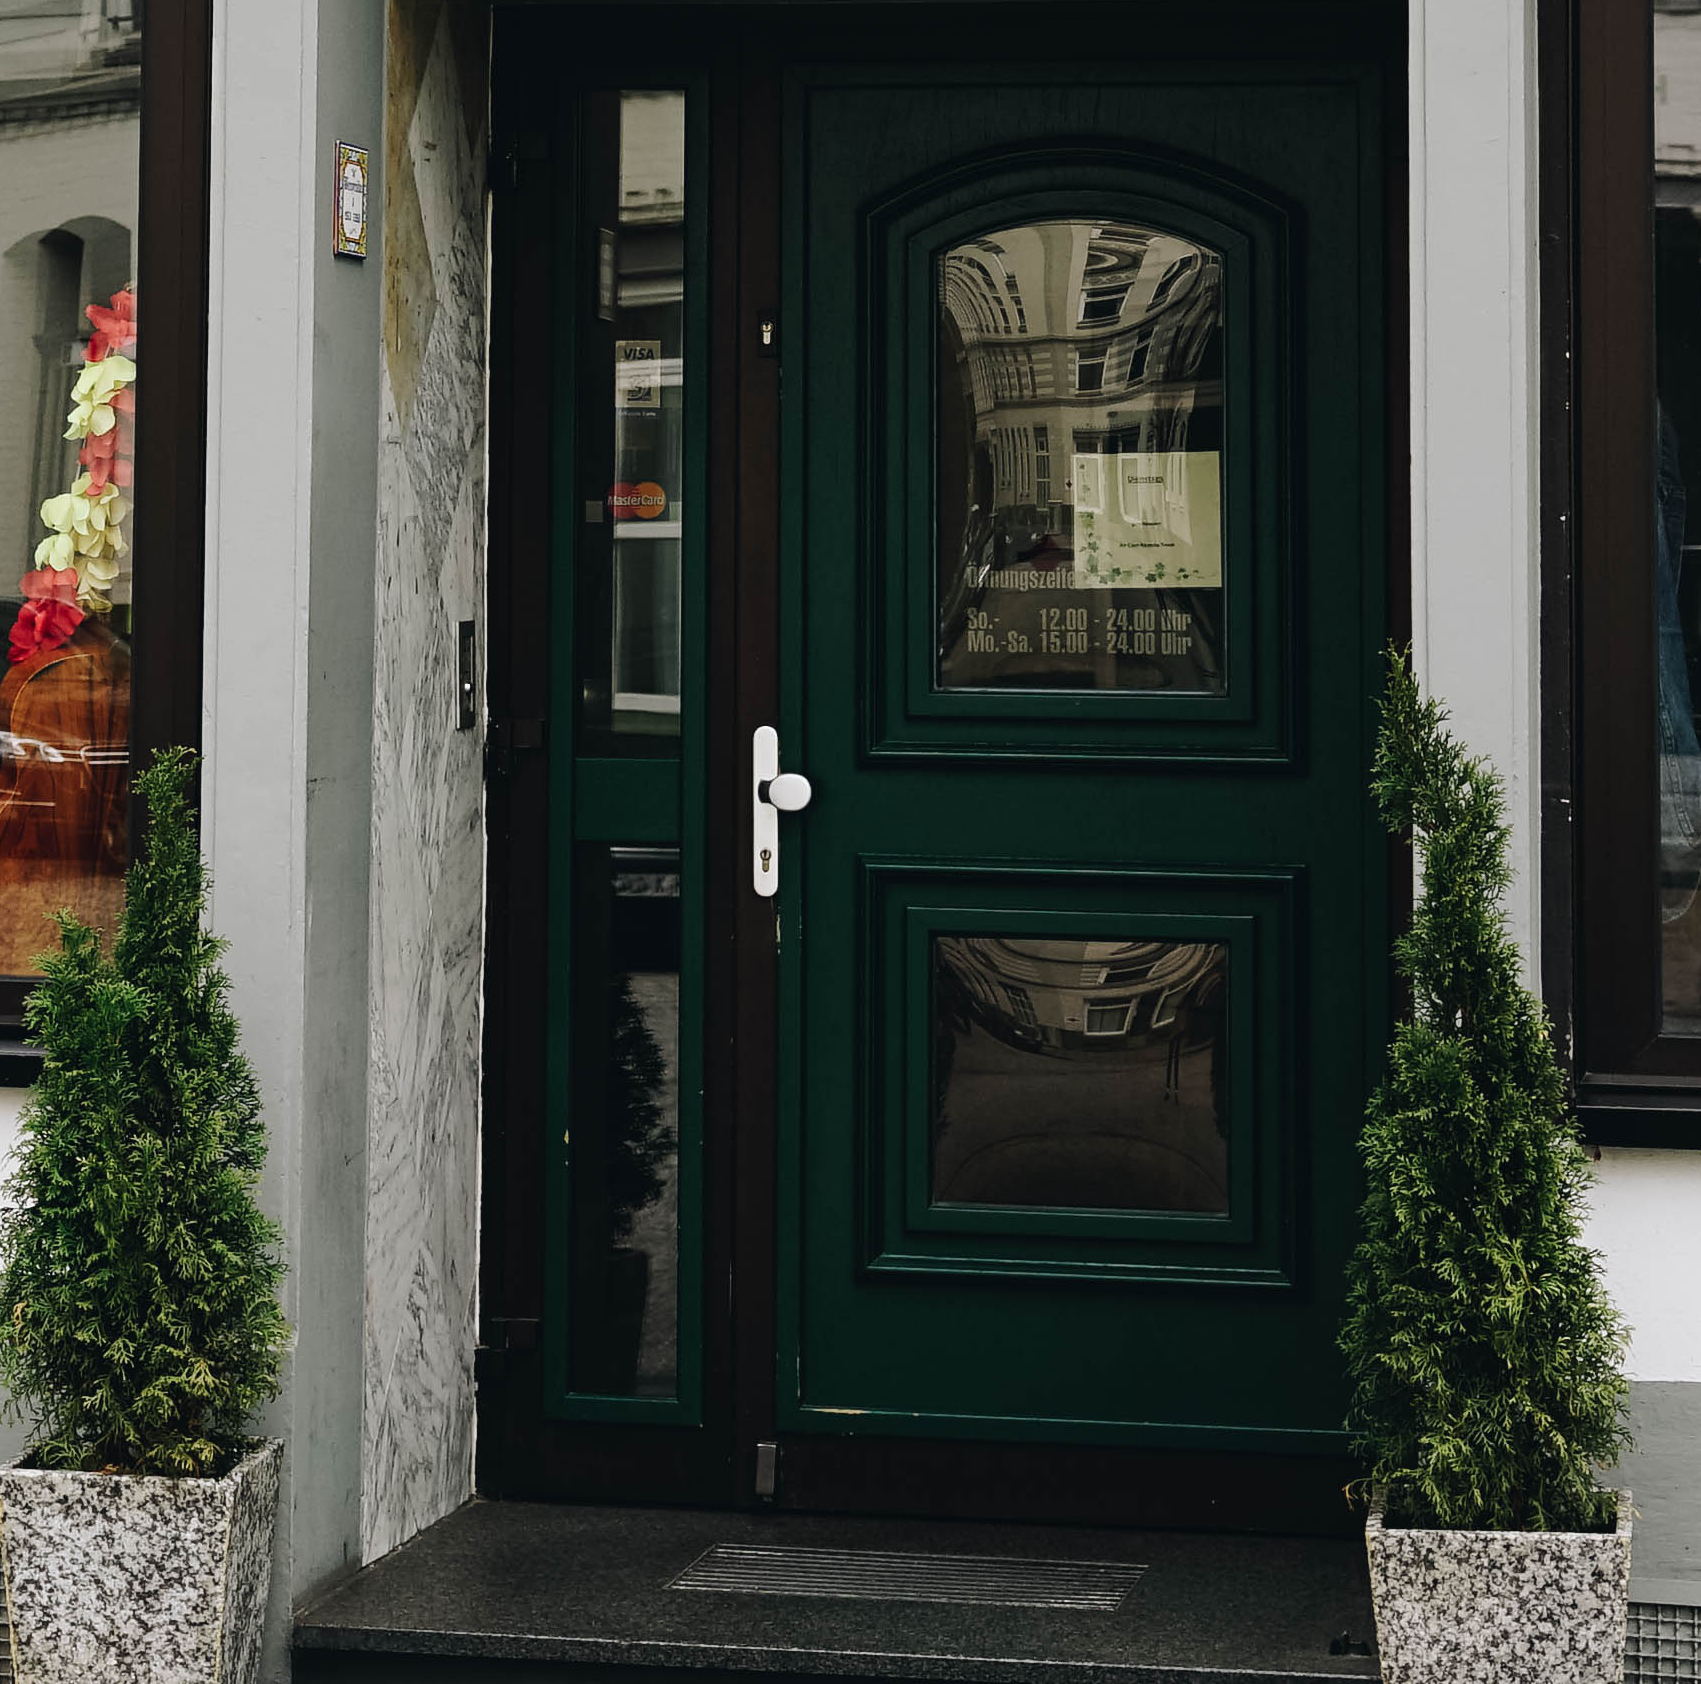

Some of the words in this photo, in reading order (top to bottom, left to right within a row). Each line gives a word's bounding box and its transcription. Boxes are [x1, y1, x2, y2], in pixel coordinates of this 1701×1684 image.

[624, 346, 656, 361] VISA
[607, 492, 667, 507] MasterCard
[1039, 608, 1088, 631] 12.00
[1106, 608, 1155, 632] 24.00
[1039, 631, 1088, 654] 15.00
[1106, 632, 1155, 655] 24.00
[1160, 632, 1193, 655] Uhr
